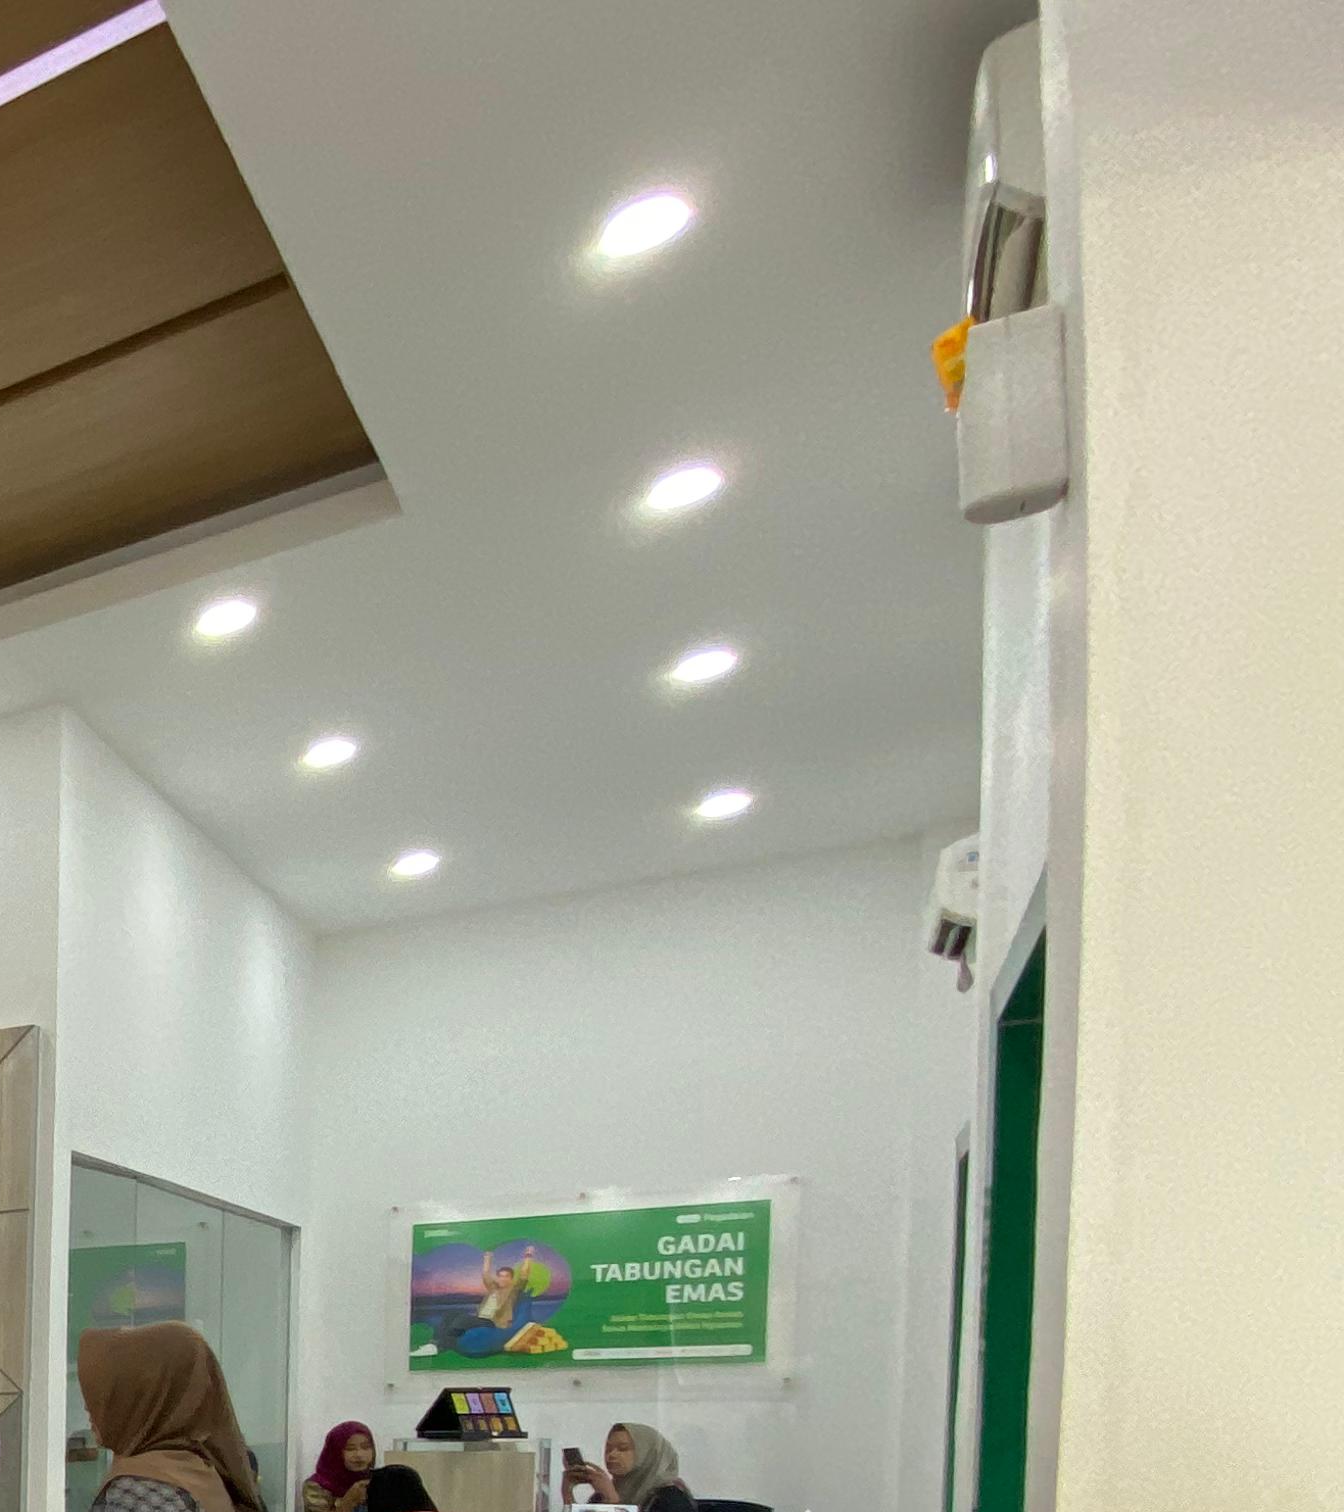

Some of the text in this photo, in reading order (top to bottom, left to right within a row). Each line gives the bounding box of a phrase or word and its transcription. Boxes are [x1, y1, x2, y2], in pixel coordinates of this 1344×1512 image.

[657, 1232, 745, 1256] GADAI
[590, 1257, 744, 1283] TABUNGAN
[665, 1281, 745, 1304] EMAS
